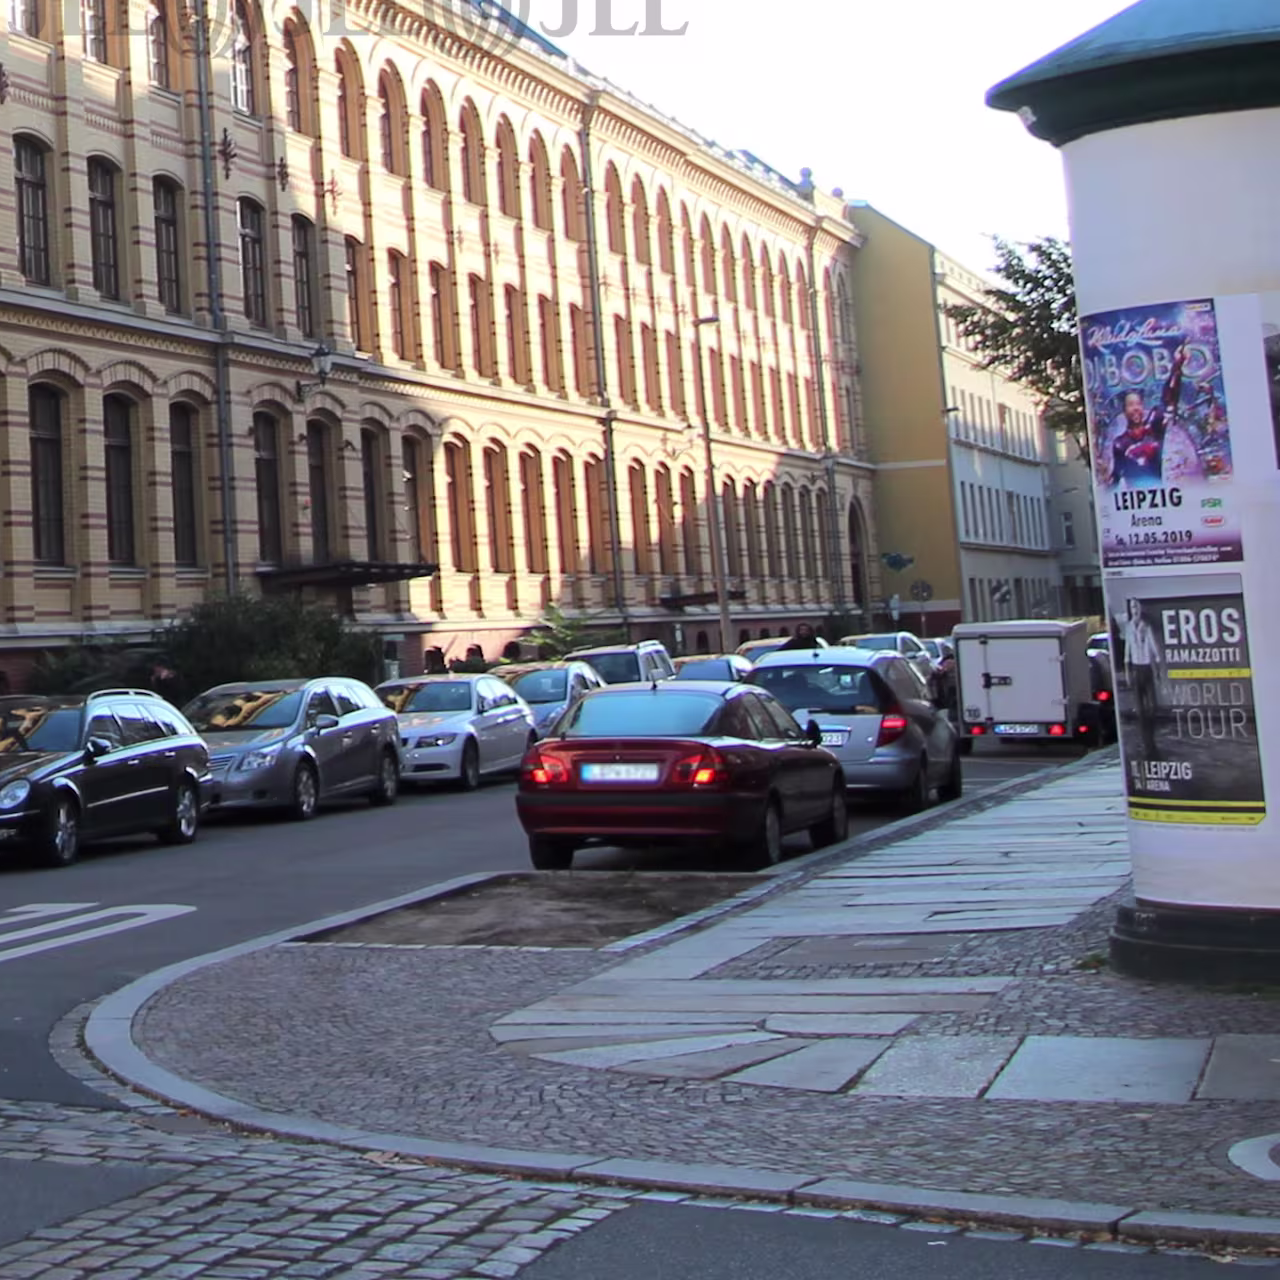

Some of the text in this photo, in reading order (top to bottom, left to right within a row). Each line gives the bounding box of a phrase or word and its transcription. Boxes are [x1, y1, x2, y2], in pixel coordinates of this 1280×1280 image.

[1114, 488, 1182, 511] LEIPZIG
[1131, 514, 1163, 527] Arena
[1128, 530, 1192, 545] 12.05.2019
[1161, 608, 1241, 645] EROS
[1165, 647, 1240, 663] RAMAZZOTTI
[1169, 682, 1244, 706] WORLD
[1171, 707, 1248, 739] TOUR
[1144, 760, 1192, 779] LEIPZIG
[1146, 780, 1171, 791] ARENA
